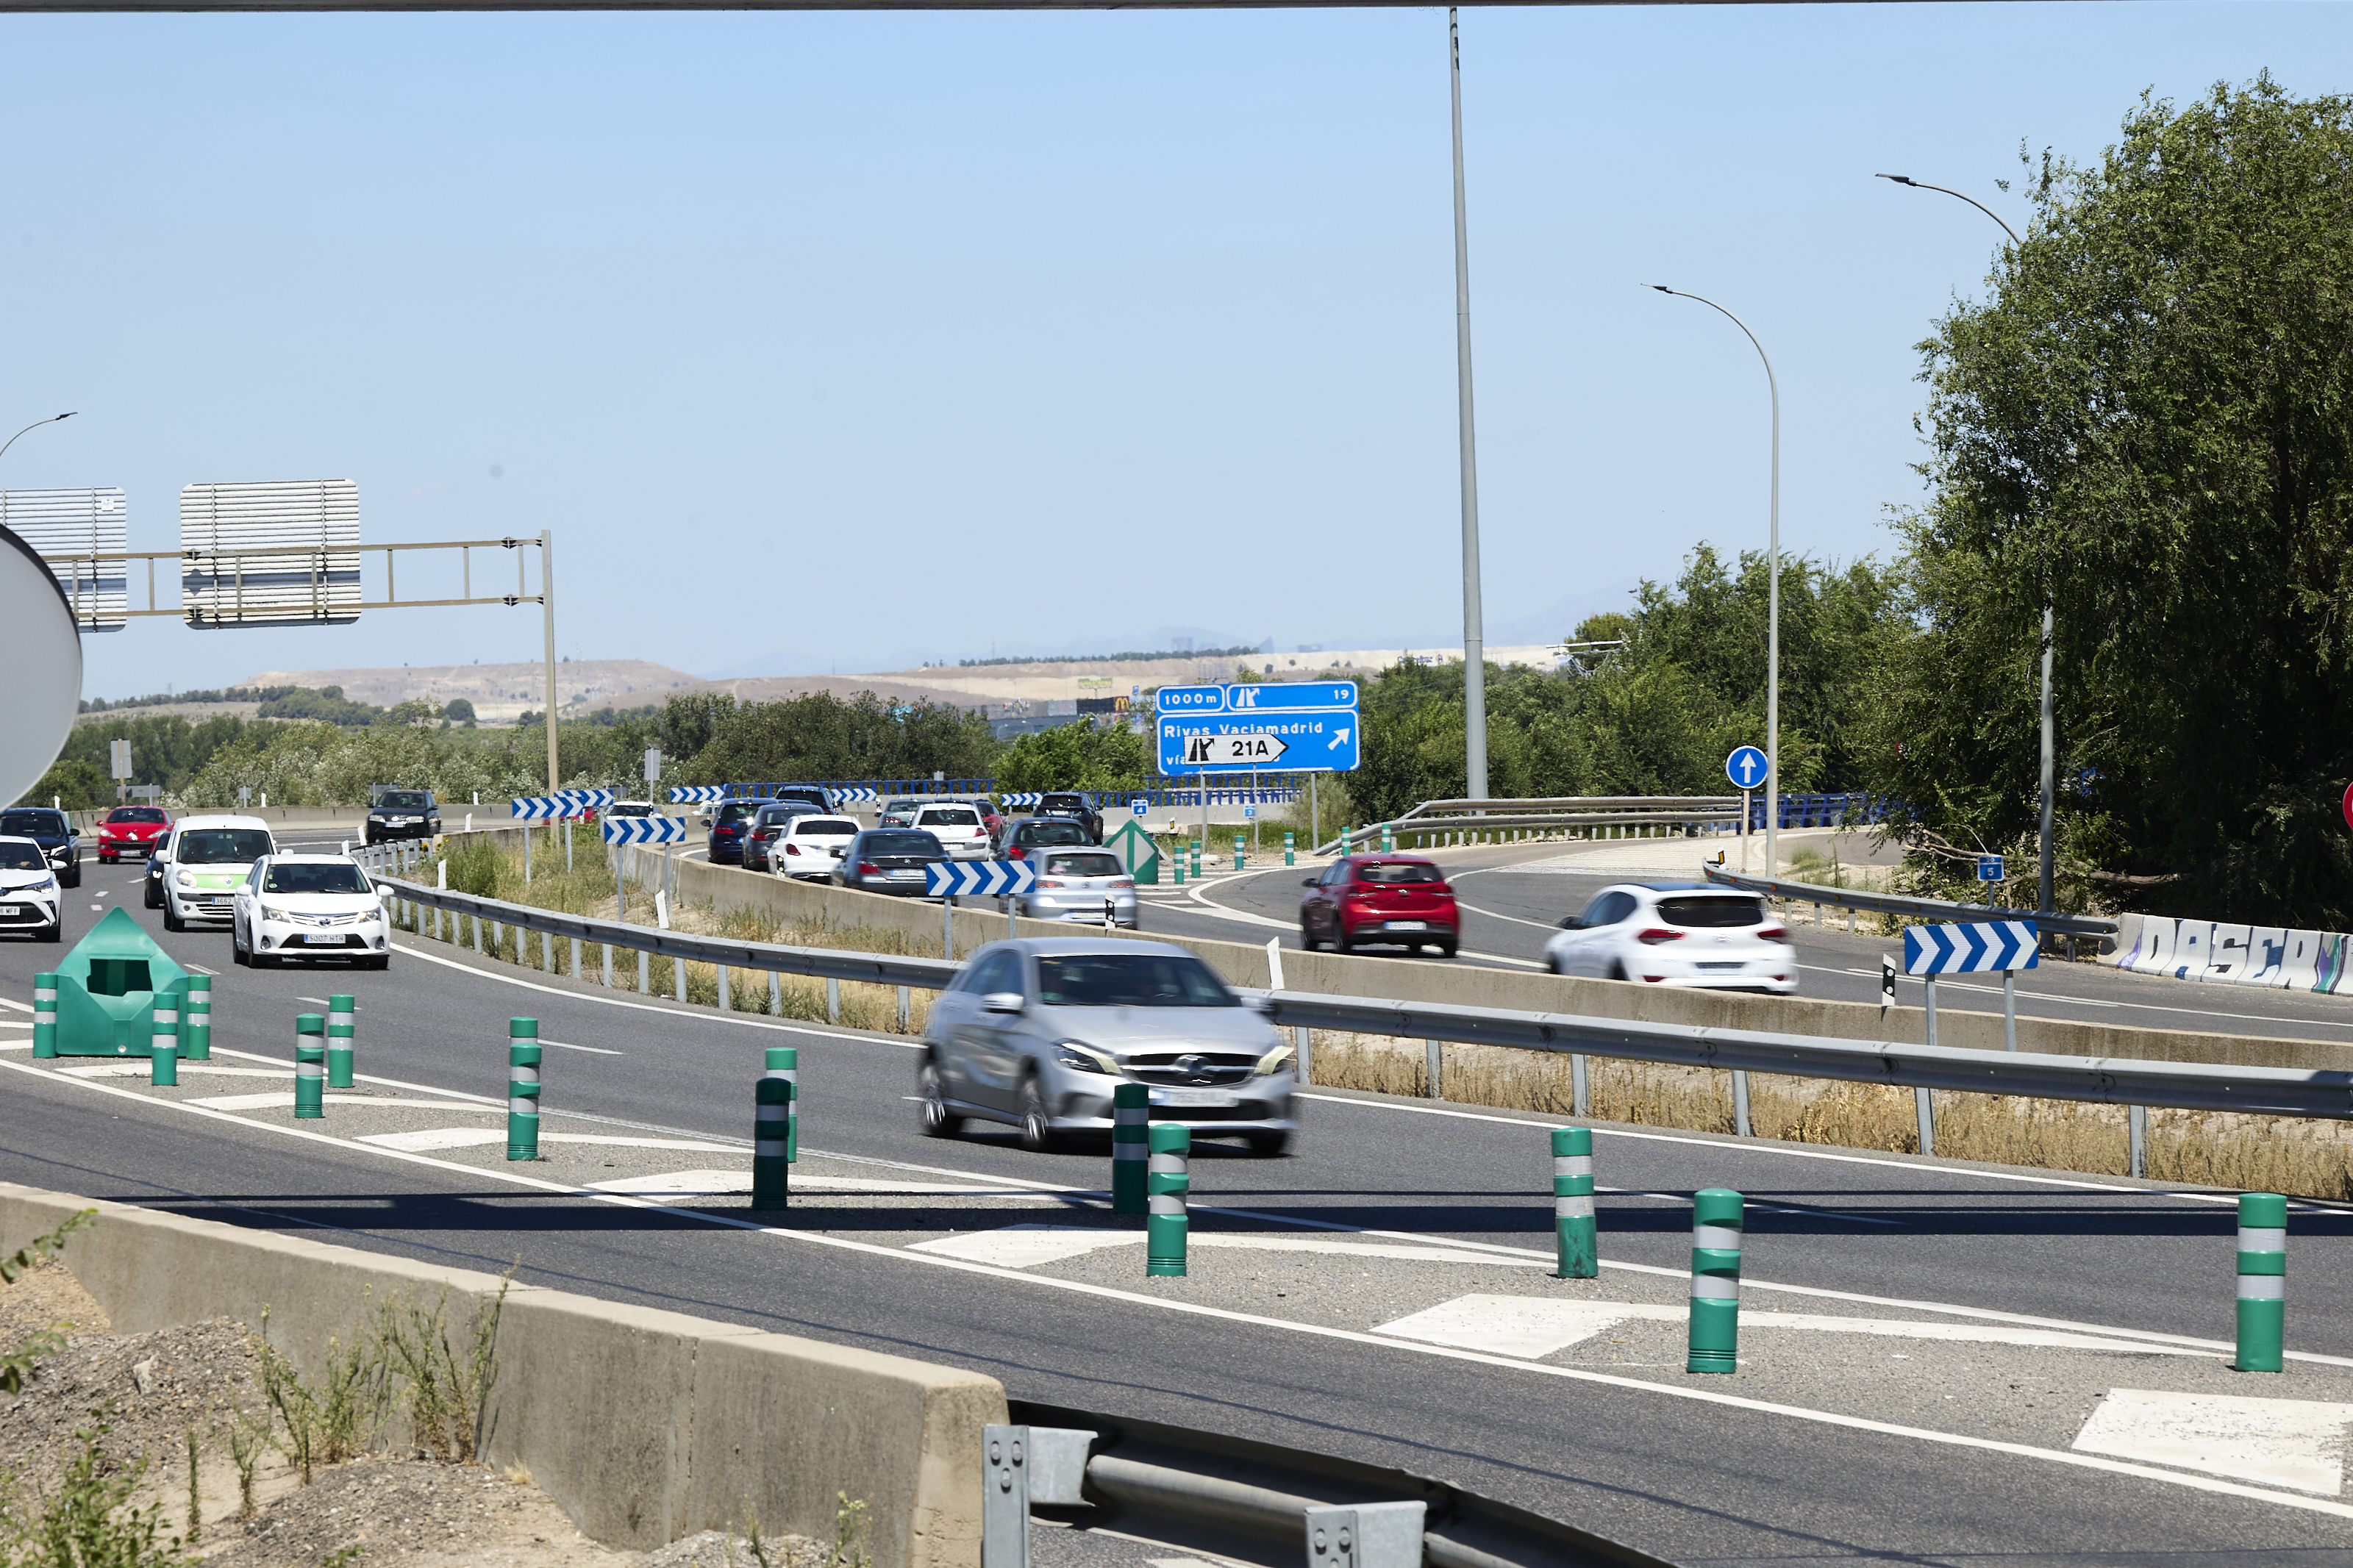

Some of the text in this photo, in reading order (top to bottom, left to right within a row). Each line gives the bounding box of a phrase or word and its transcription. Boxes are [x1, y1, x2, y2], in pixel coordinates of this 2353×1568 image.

[1334, 689, 1349, 700] 19
[1164, 722, 1323, 737] Rivas Vaciamadrid
[1232, 740, 1268, 756] 21A
[1987, 867, 1994, 876] 5
